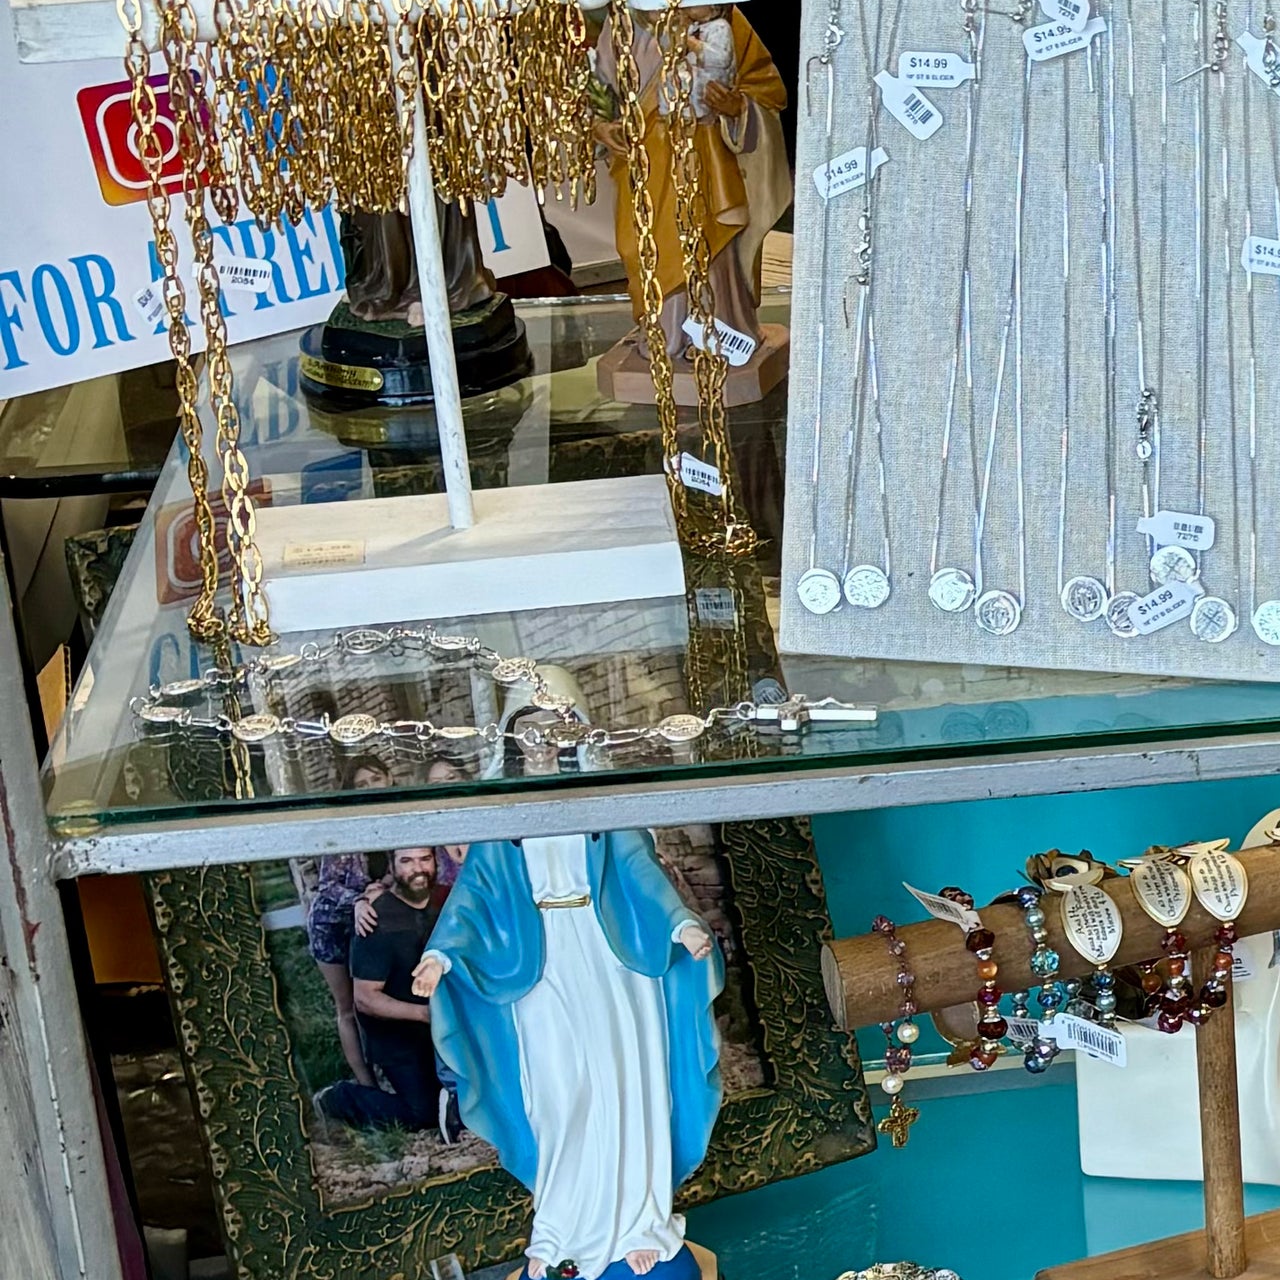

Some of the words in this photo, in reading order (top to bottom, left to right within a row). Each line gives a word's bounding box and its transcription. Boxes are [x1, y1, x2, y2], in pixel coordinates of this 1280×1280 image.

[909, 56, 948, 69] $14.99
[0, 252, 135, 371] FOR
[1137, 589, 1174, 616] $14.99
